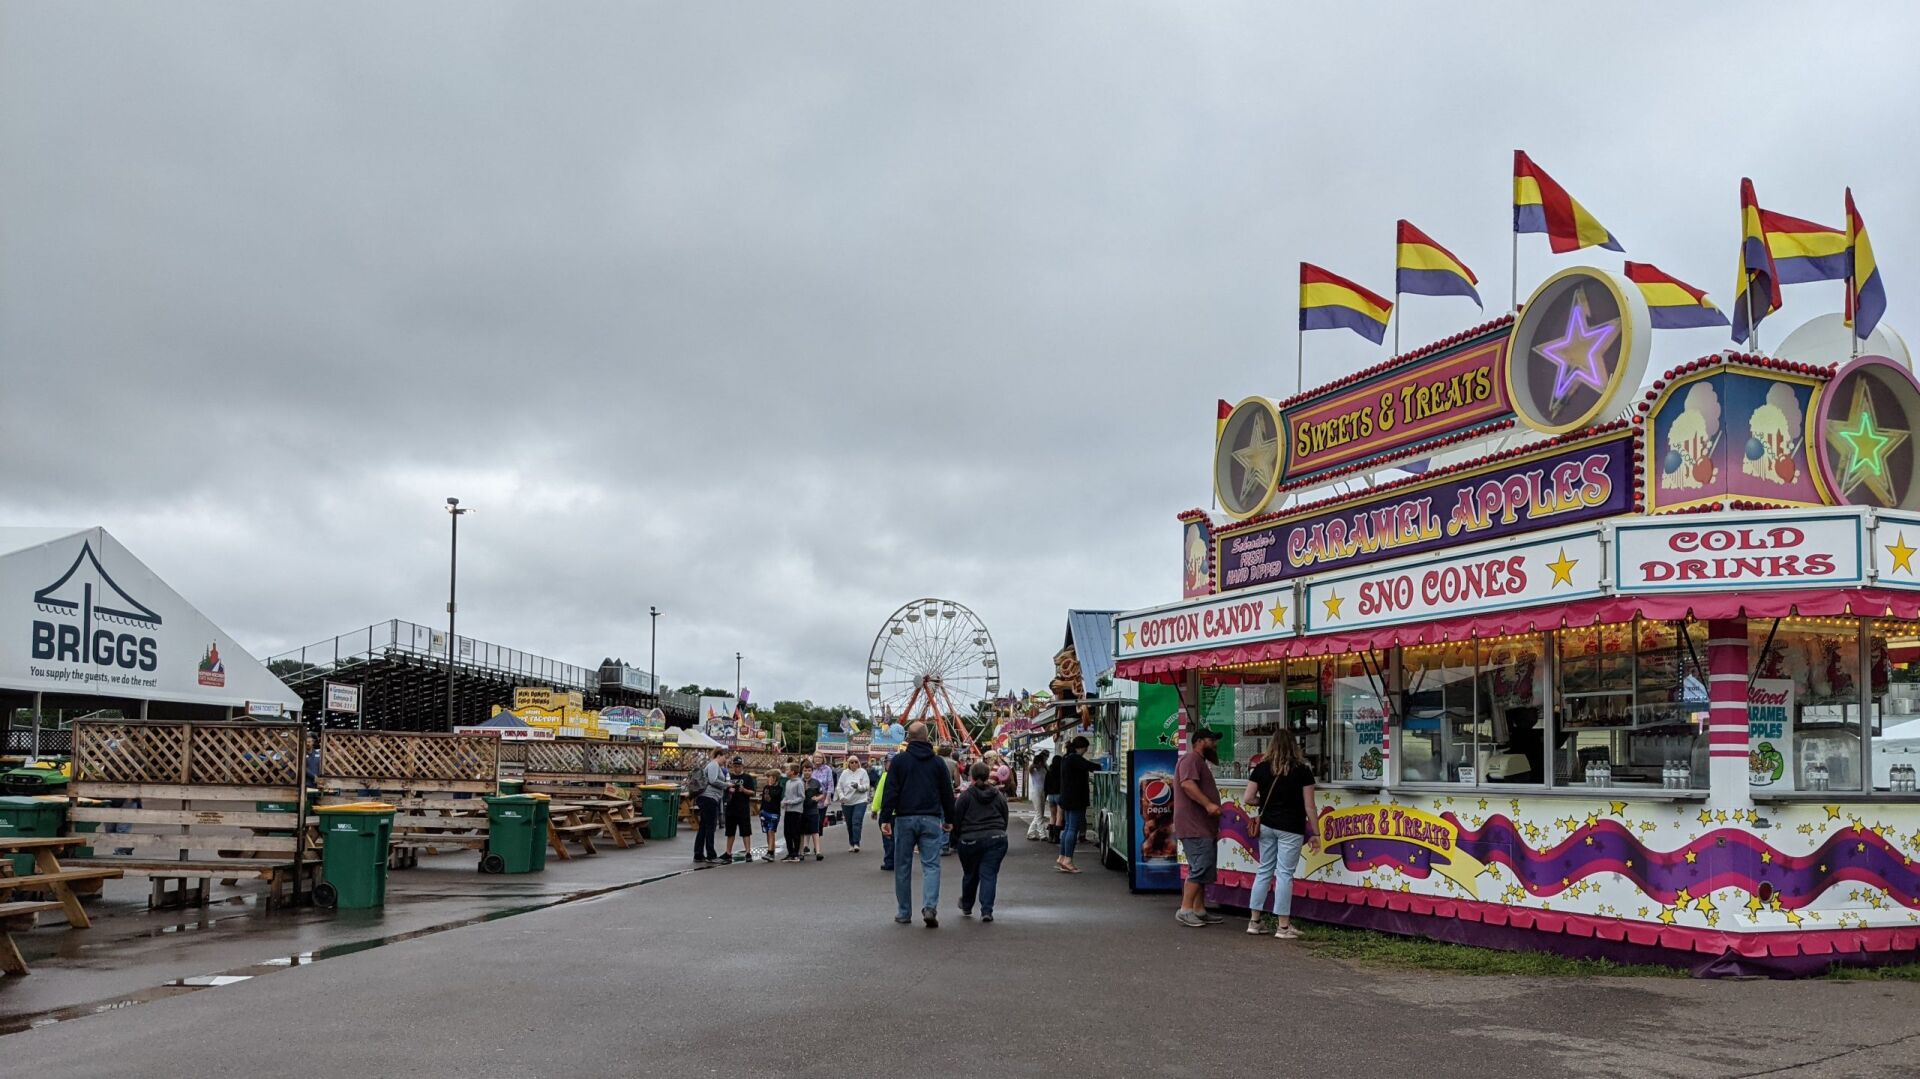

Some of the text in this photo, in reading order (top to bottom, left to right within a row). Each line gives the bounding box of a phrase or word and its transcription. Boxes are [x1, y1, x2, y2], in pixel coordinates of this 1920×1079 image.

[1297, 366, 1492, 458] SWEETS & TREATS
[1287, 454, 1612, 567] CARAMEL APPLES
[1668, 527, 1805, 553] COLD
[1240, 547, 1266, 567] FRESH
[1639, 553, 1836, 582] DRINKS
[1226, 560, 1282, 585] HAND DIPPED
[1358, 555, 1527, 615] SNO CONES
[1140, 600, 1264, 648] COTTON CANDY
[32, 619, 157, 671] BRIGGS
[30, 666, 158, 687] You supply the guests, we do the rest!
[1355, 719, 1384, 733] CARAM
[1749, 706, 1788, 722] RAMEL
[1359, 732, 1384, 745] APPLE
[1749, 723, 1783, 739] PPLES
[1147, 806, 1172, 816] pepsi
[1324, 808, 1450, 850] SWEETS & TREATS
